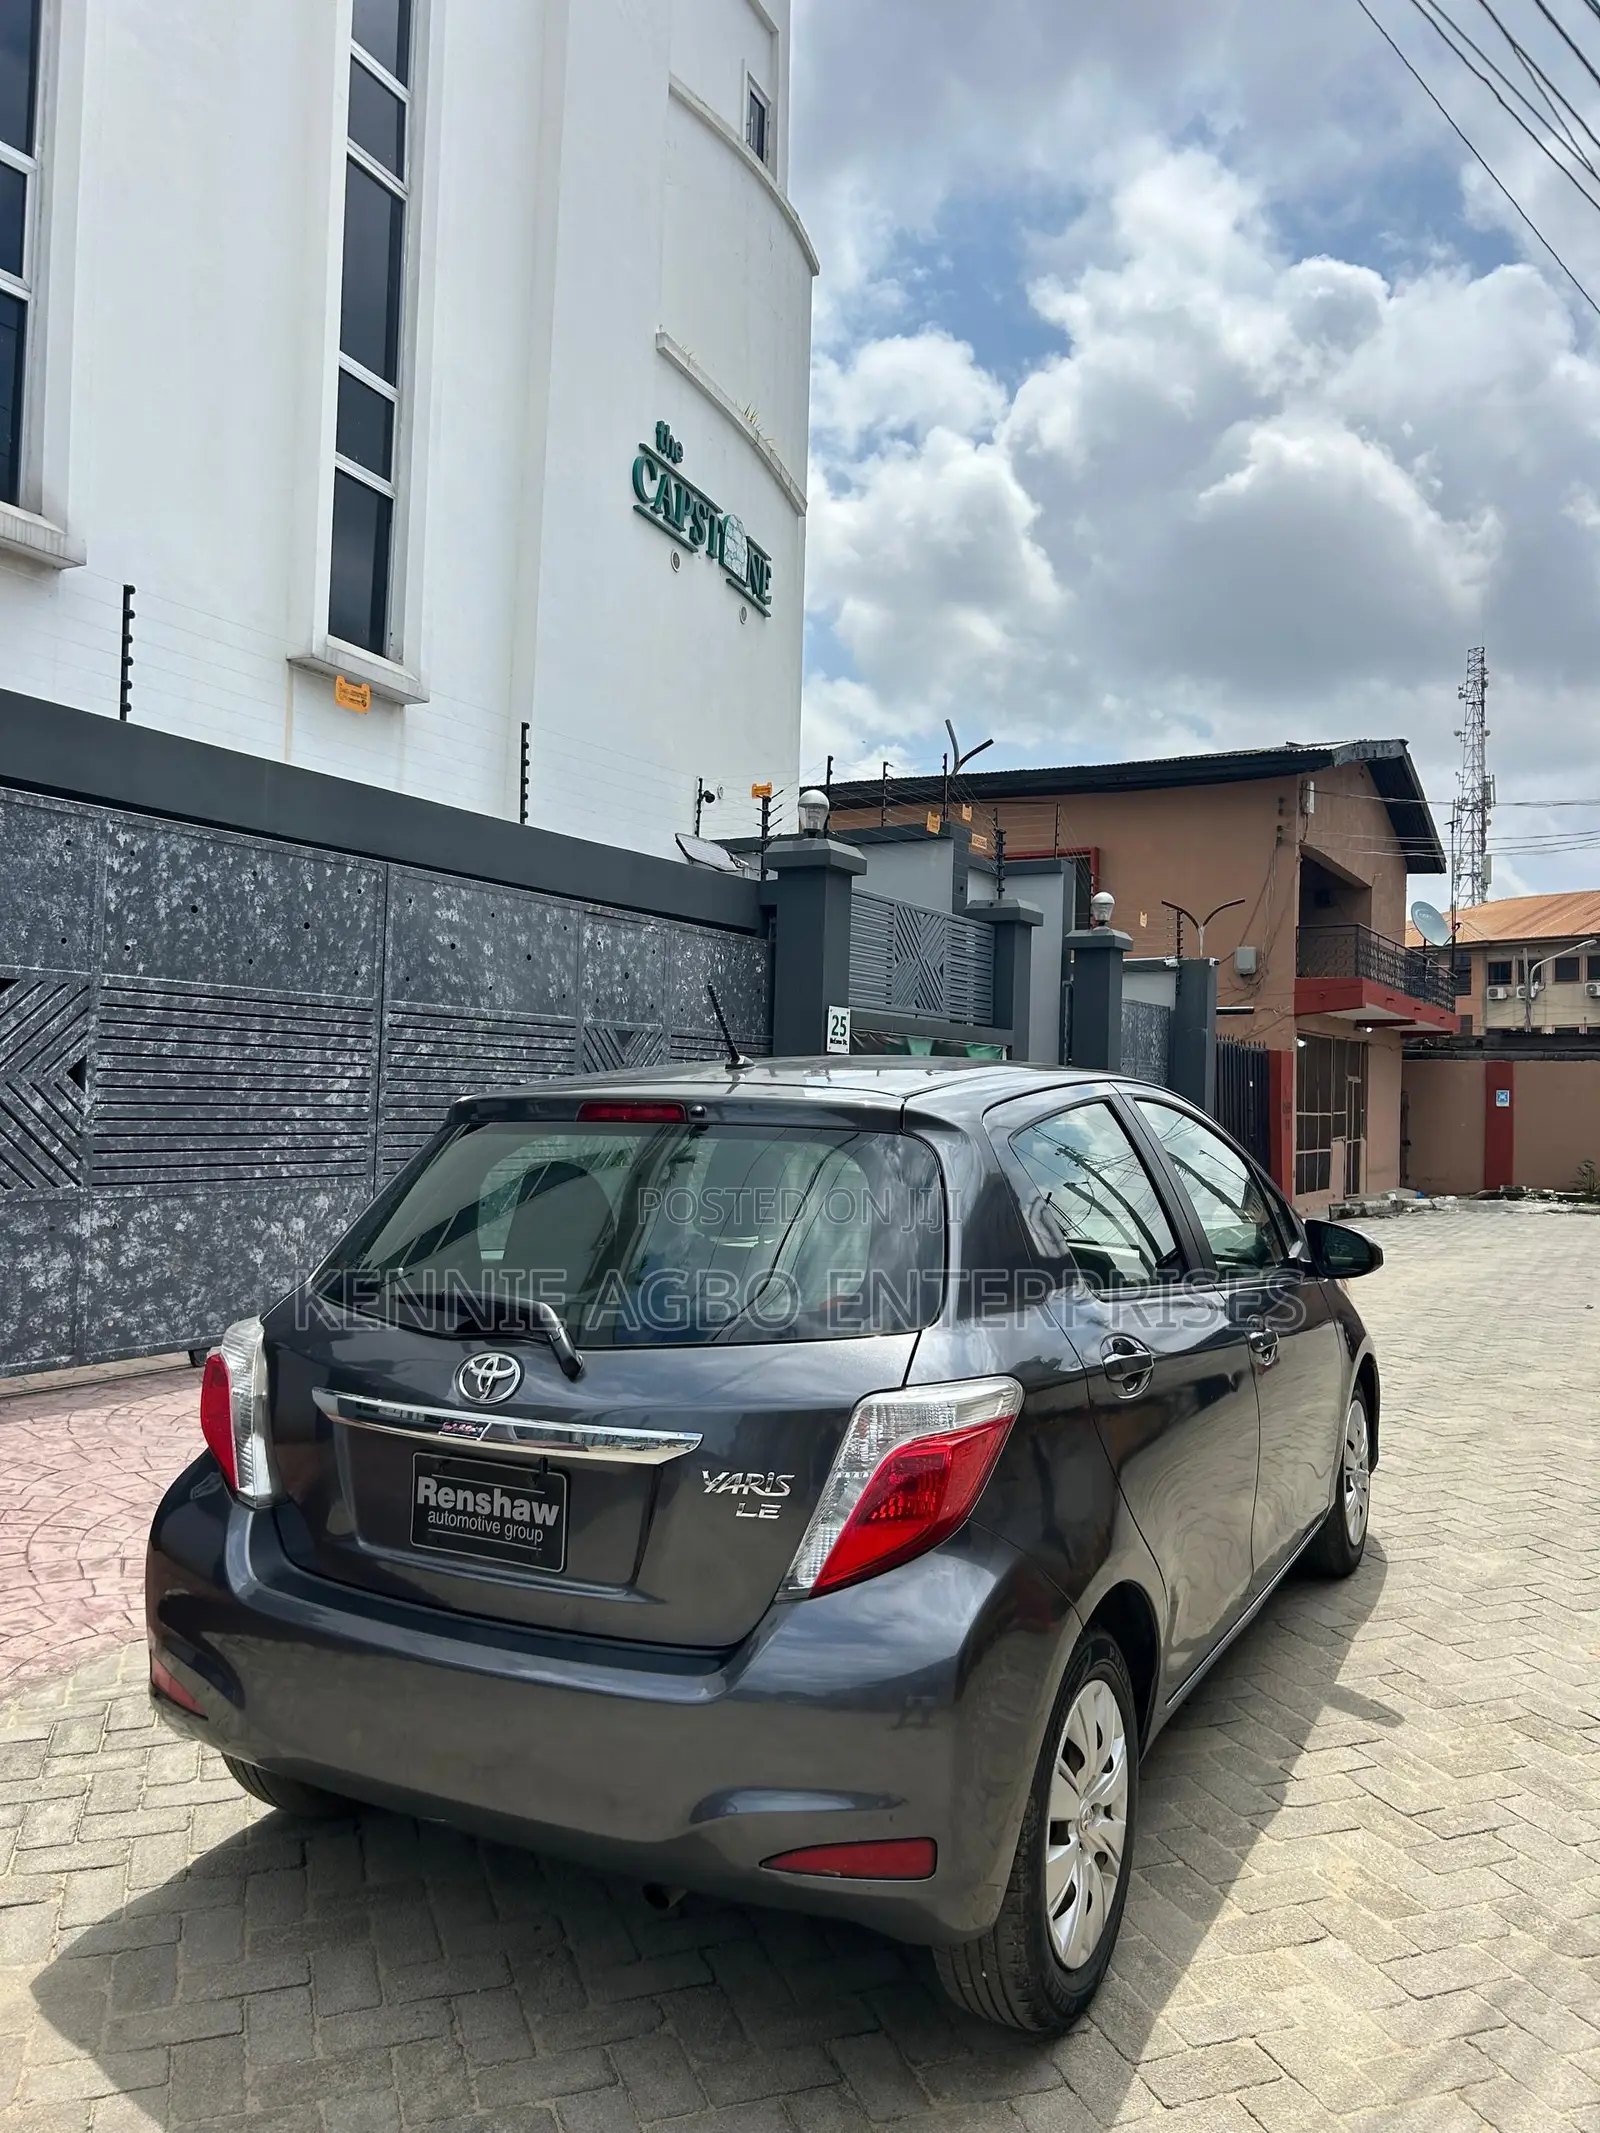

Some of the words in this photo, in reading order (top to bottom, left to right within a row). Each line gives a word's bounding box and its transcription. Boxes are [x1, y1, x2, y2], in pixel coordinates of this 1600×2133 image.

[656, 420, 684, 464] the
[831, 1014, 847, 1037] 25
[417, 1476, 560, 1527] Renshaw
[735, 1502, 782, 1520] LE
[428, 1510, 501, 1534] automotive
[504, 1523, 544, 1545] group
